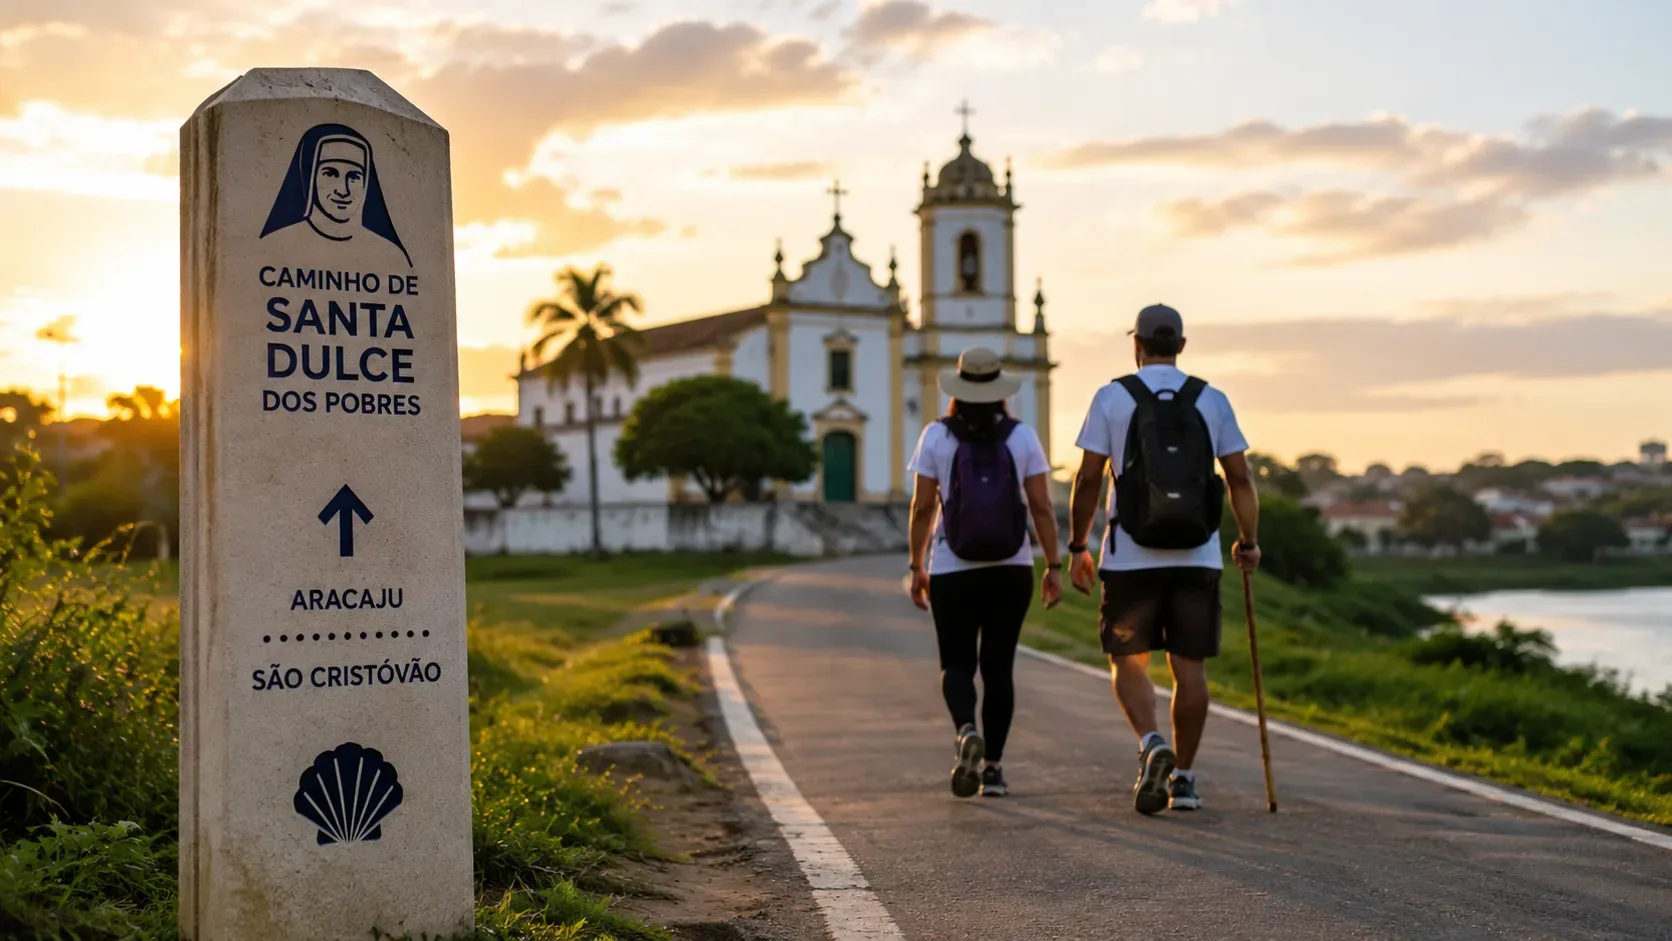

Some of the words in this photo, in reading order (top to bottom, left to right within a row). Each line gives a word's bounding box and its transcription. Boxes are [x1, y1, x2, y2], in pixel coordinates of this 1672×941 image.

[259, 266, 380, 293] CAMINHO
[388, 275, 419, 296] DE
[266, 297, 414, 339] SANTA
[267, 343, 415, 384] DULCE
[262, 390, 317, 413] DOS
[325, 392, 421, 416] POBRES
[290, 588, 403, 610] ARACAJU
[252, 663, 303, 691] SÃO
[310, 657, 441, 688] CRISTÓVÃO
